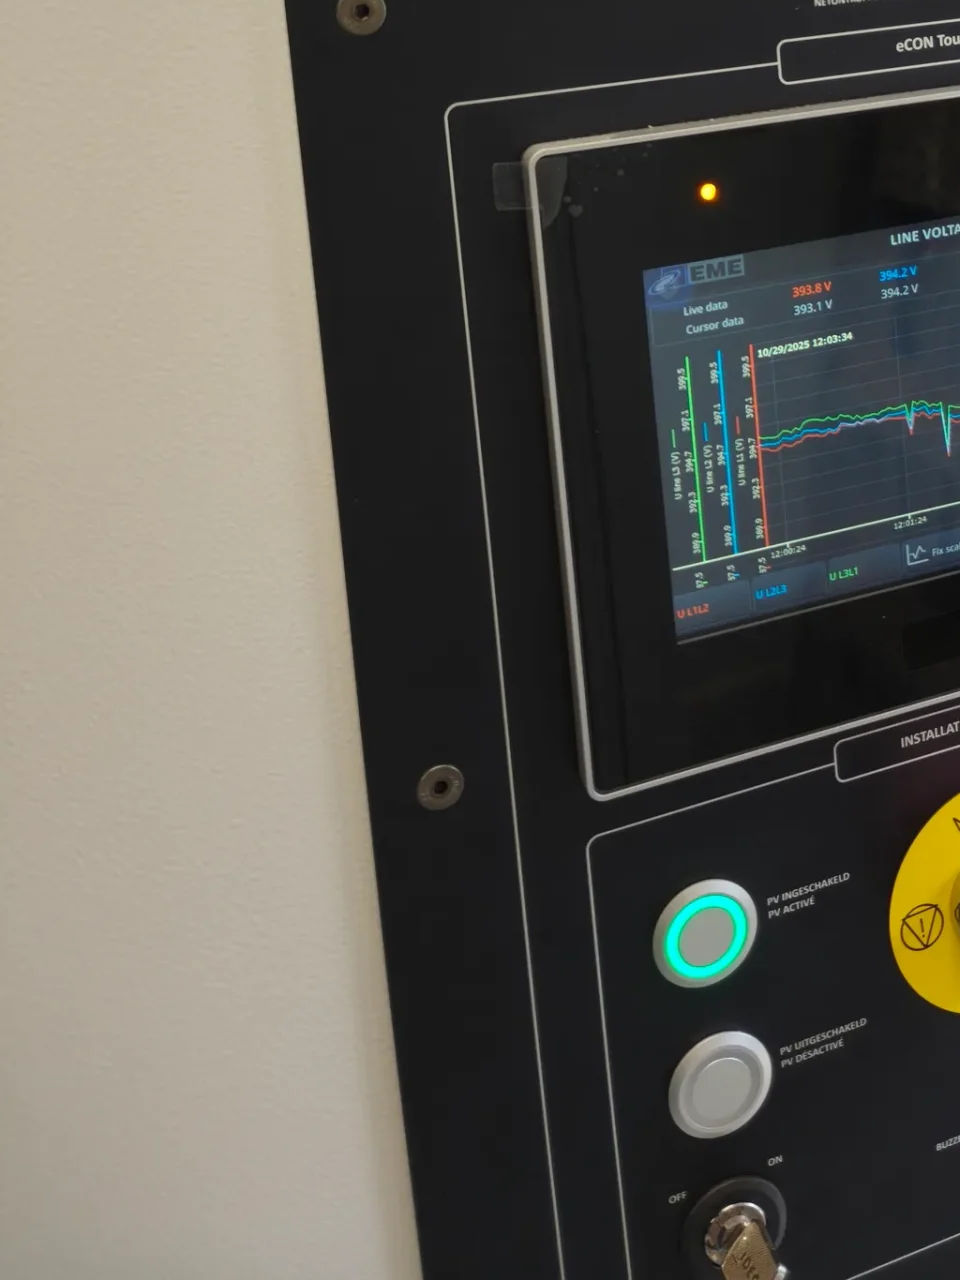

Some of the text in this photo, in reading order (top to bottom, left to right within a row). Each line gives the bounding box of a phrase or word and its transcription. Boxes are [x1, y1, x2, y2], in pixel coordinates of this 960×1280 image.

[895, 36, 934, 52] eCON
[890, 229, 919, 246] LINE
[691, 258, 743, 281] EME
[683, 305, 703, 316] Live
[705, 300, 728, 314] data
[792, 283, 822, 298] 393.8
[824, 281, 832, 292] V
[879, 266, 908, 281] 394.2
[909, 265, 918, 276] V
[686, 321, 720, 335] Cursor
[722, 316, 744, 329] data
[794, 301, 822, 316] 393.1
[824, 299, 833, 310] V
[881, 285, 909, 299] 394.2
[910, 284, 919, 294] V
[757, 332, 853, 358] 10/29/2025 12:03:34
[703, 444, 713, 455] (V)
[735, 438, 744, 449] (V)
[671, 451, 680, 462] (V)
[704, 456, 712, 467] L2
[735, 450, 744, 460] L1
[672, 463, 680, 473] L3
[736, 462, 745, 477] line
[674, 475, 682, 492] line
[705, 468, 713, 484] line
[893, 515, 928, 530] 12:01:24
[771, 544, 806, 559] 12:00:24
[931, 547, 944, 557] Fix
[829, 566, 859, 581] U L3L1
[755, 584, 787, 600] U L2L3
[676, 604, 710, 619] U L1L2
[766, 872, 851, 907] PV INGESCHAKELD
[767, 895, 816, 919] PV ACTIVÉ
[780, 1017, 868, 1056] PV UITGESCHAKELD
[780, 1058, 794, 1068] PV
[768, 1155, 784, 1167] ON
[668, 1191, 688, 1205] OFF
